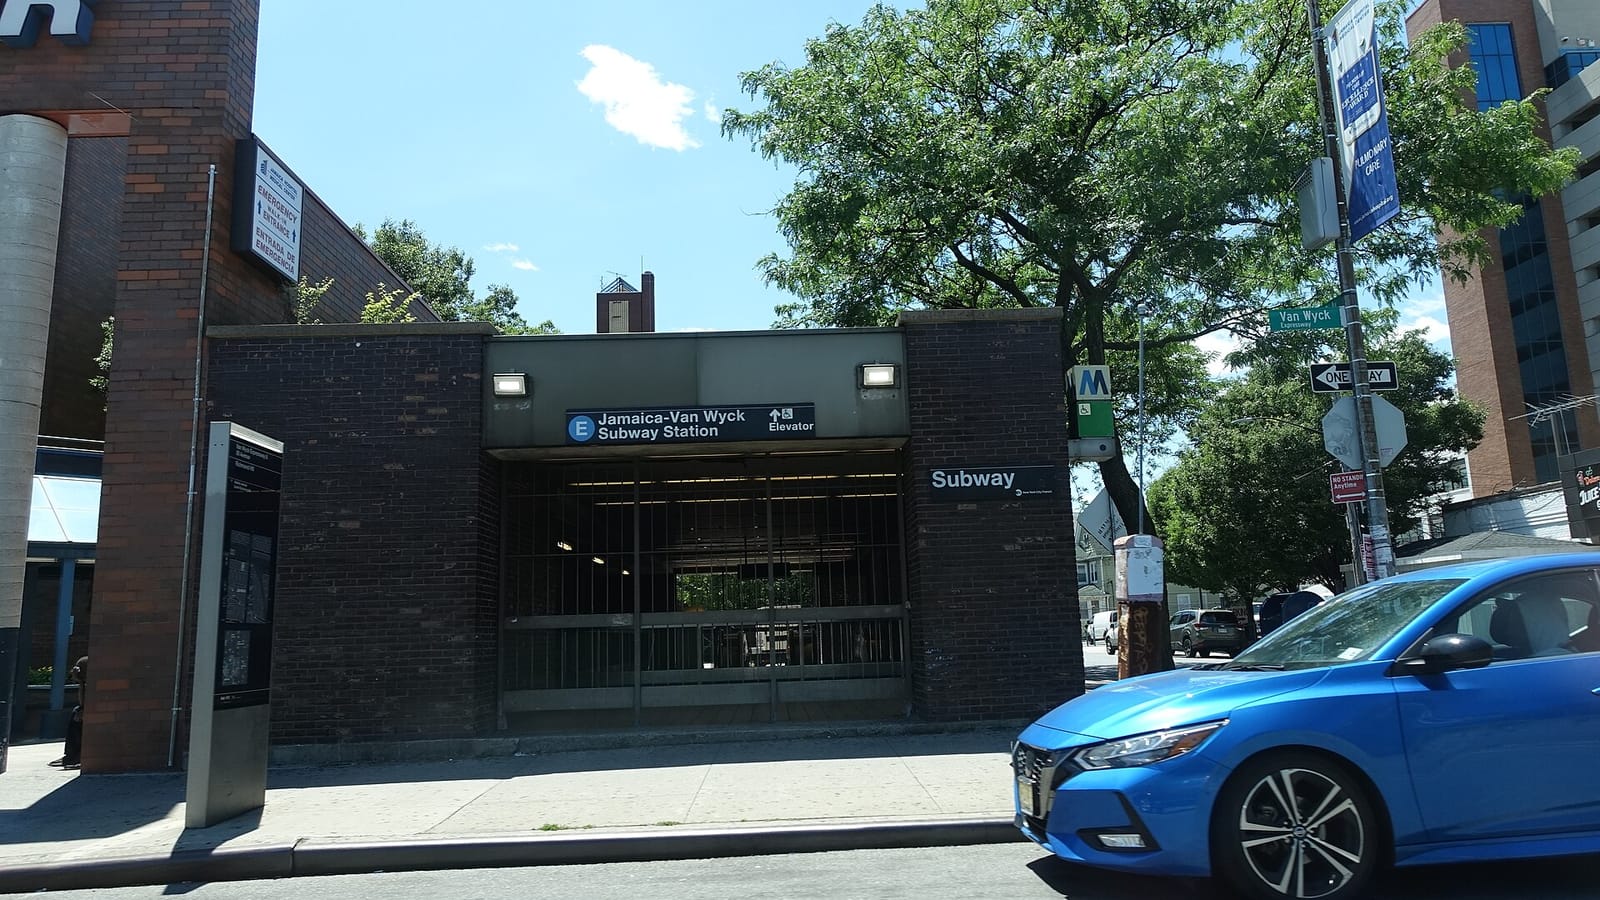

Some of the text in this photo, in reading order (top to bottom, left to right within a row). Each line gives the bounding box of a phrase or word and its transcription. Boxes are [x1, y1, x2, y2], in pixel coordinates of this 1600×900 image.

[1355, 136, 1388, 169] PULMONARY
[1365, 158, 1381, 176] CARE
[257, 184, 297, 224] EMERGENCY
[263, 211, 290, 240] ENTRANCE
[255, 226, 296, 264] ENTRADA DE
[255, 239, 295, 275] EMERGENCIA
[1280, 310, 1331, 322] Van Wyck
[1325, 372, 1349, 383] ONE
[598, 409, 746, 425] Jamaica-Van Wyck
[575, 421, 588, 436] E
[598, 425, 719, 441] Subway Station
[769, 421, 814, 431] Elevator
[931, 470, 1015, 489] Subway
[1333, 482, 1357, 490] Anytime
